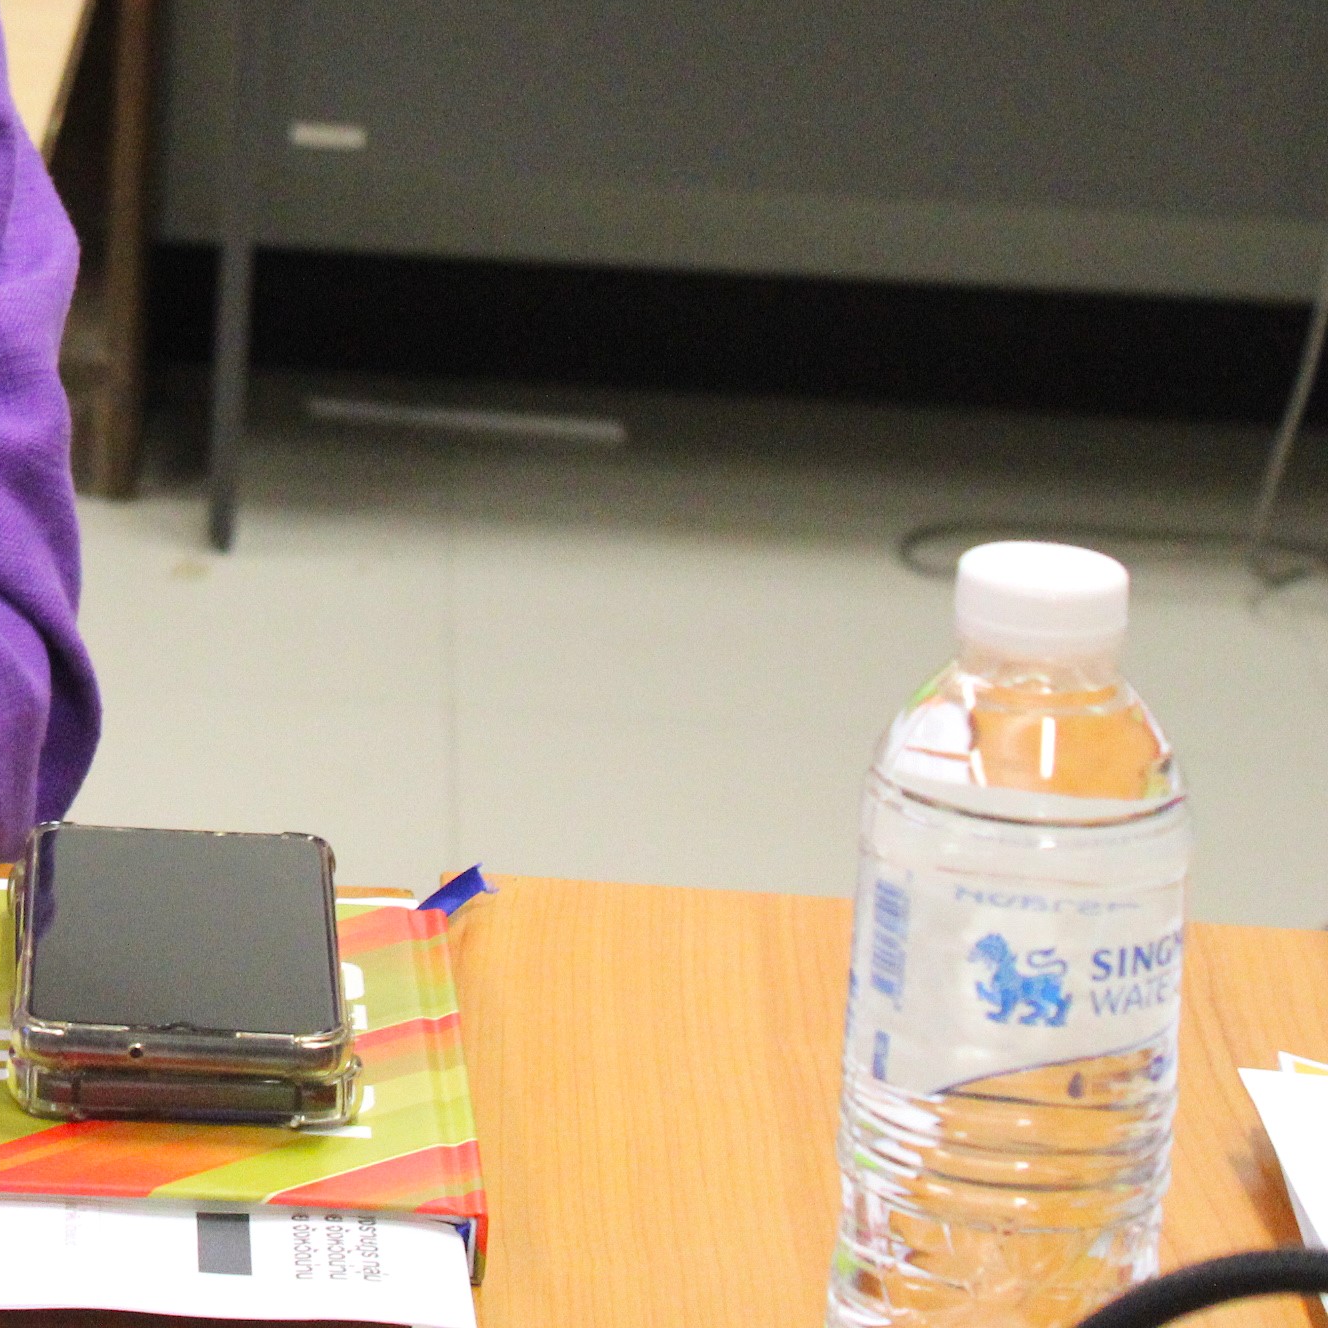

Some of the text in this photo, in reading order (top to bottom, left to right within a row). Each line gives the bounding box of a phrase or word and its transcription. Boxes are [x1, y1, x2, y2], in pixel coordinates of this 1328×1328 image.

[292, 1223, 321, 1280] จังหวัดน่าน
[325, 1223, 355, 1280] จังหวัดน่าน
